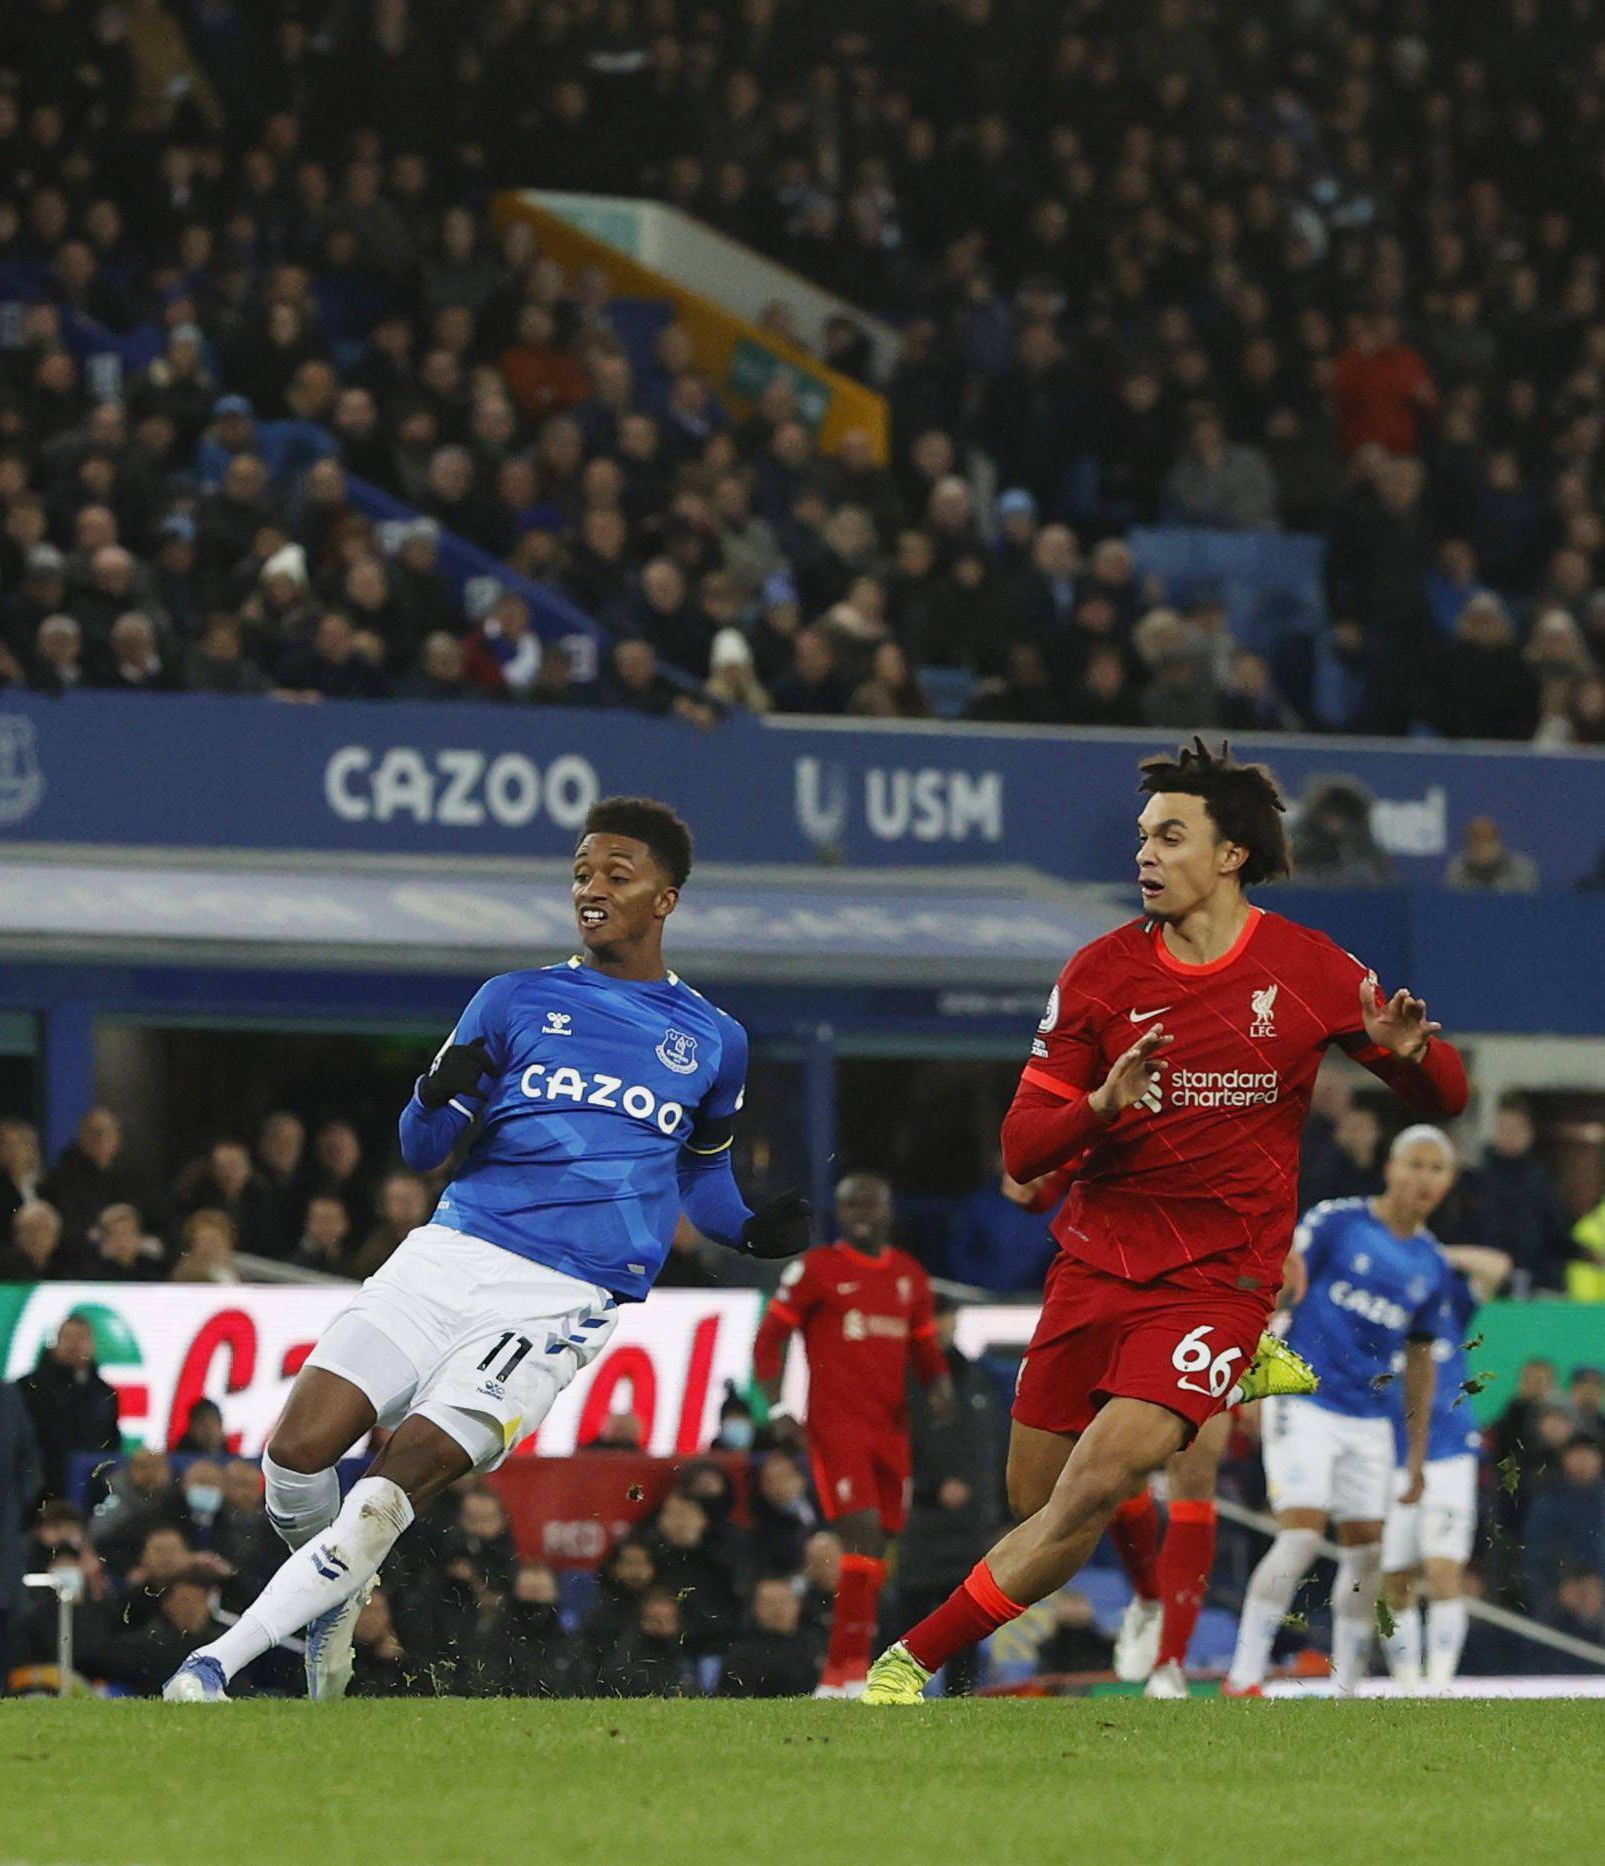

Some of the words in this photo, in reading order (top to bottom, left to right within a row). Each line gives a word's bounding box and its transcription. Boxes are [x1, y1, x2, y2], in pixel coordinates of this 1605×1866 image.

[324, 745, 598, 830] CAZOO
[865, 767, 1003, 843] USM
[520, 1064, 684, 1135] CAZOO
[1171, 1069, 1278, 1088] standard
[1171, 1087, 1279, 1107] chartered
[476, 1331, 534, 1383] 11
[1172, 1325, 1243, 1398] 66
